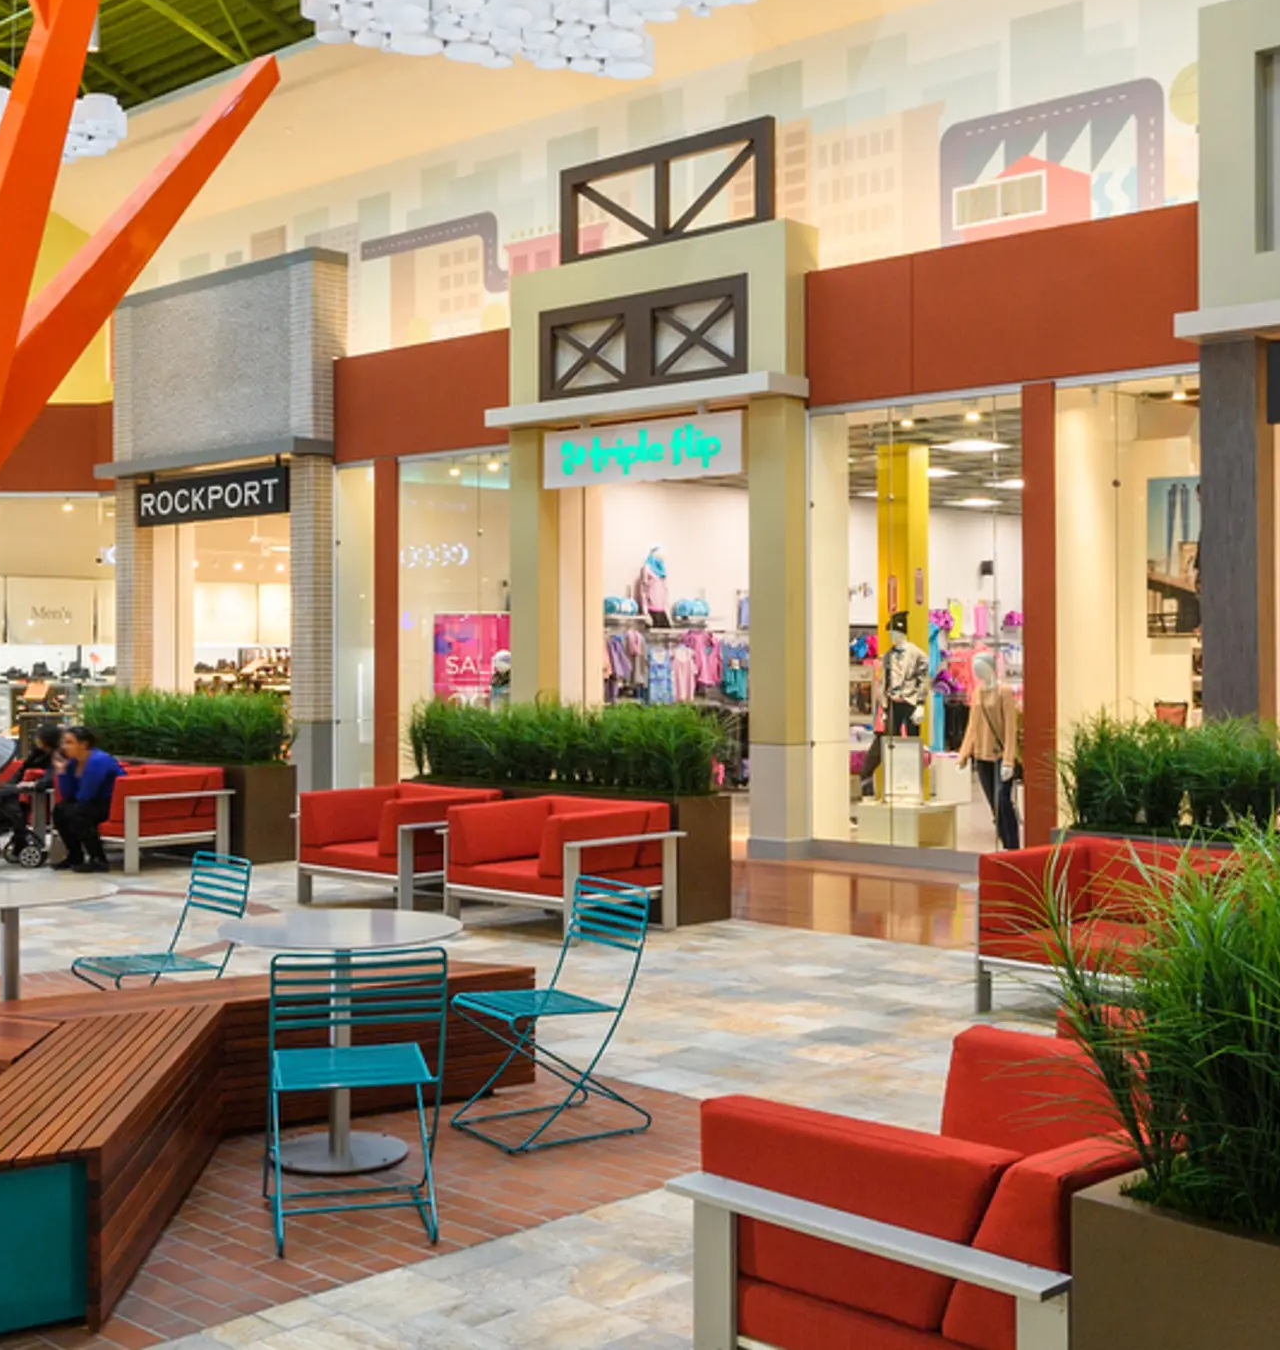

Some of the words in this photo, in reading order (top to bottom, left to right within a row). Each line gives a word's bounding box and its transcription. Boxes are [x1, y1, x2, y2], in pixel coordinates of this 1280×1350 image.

[587, 428, 664, 476] triple
[669, 422, 722, 469] flip
[140, 478, 280, 517] ROCKPORT
